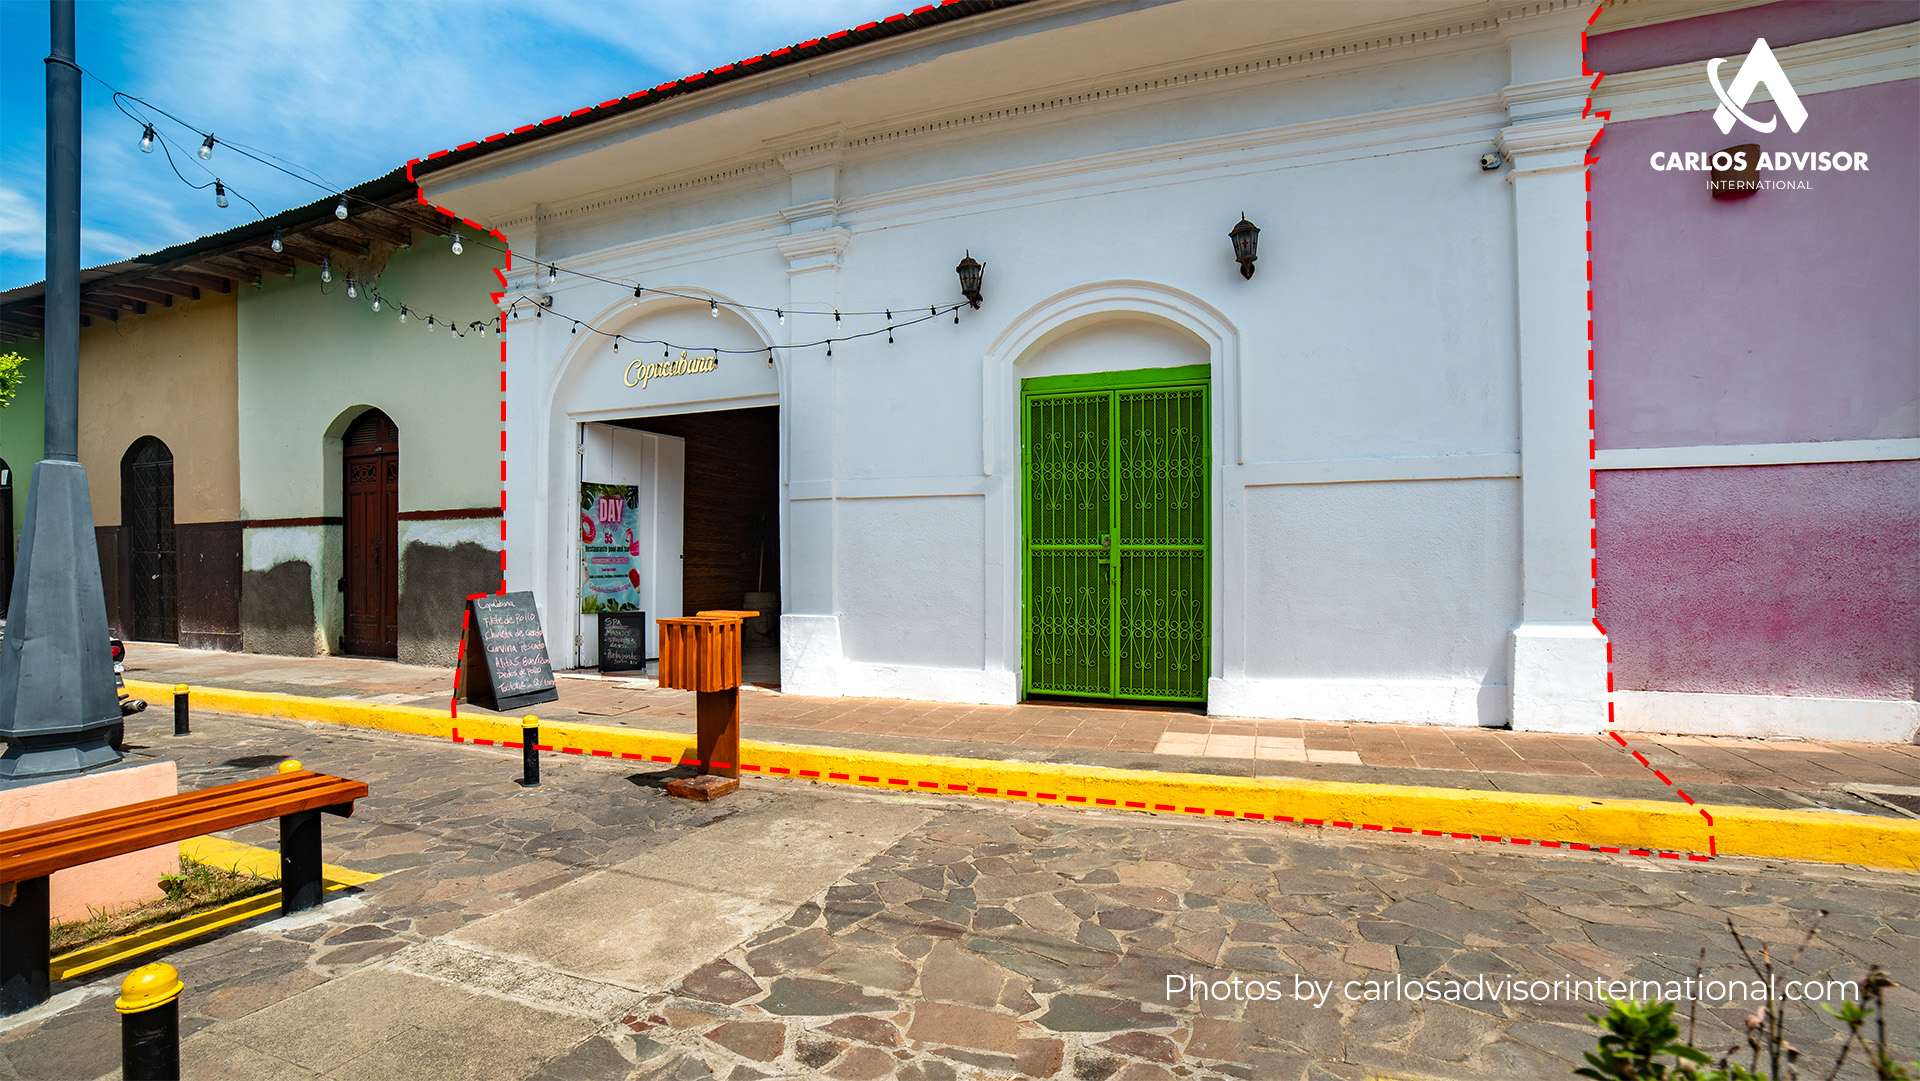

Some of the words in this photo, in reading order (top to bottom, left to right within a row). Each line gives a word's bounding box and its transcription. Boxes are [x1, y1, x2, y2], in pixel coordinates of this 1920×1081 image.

[624, 350, 716, 389] Copacabana
[599, 498, 623, 523] DAY
[514, 628, 524, 637] de
